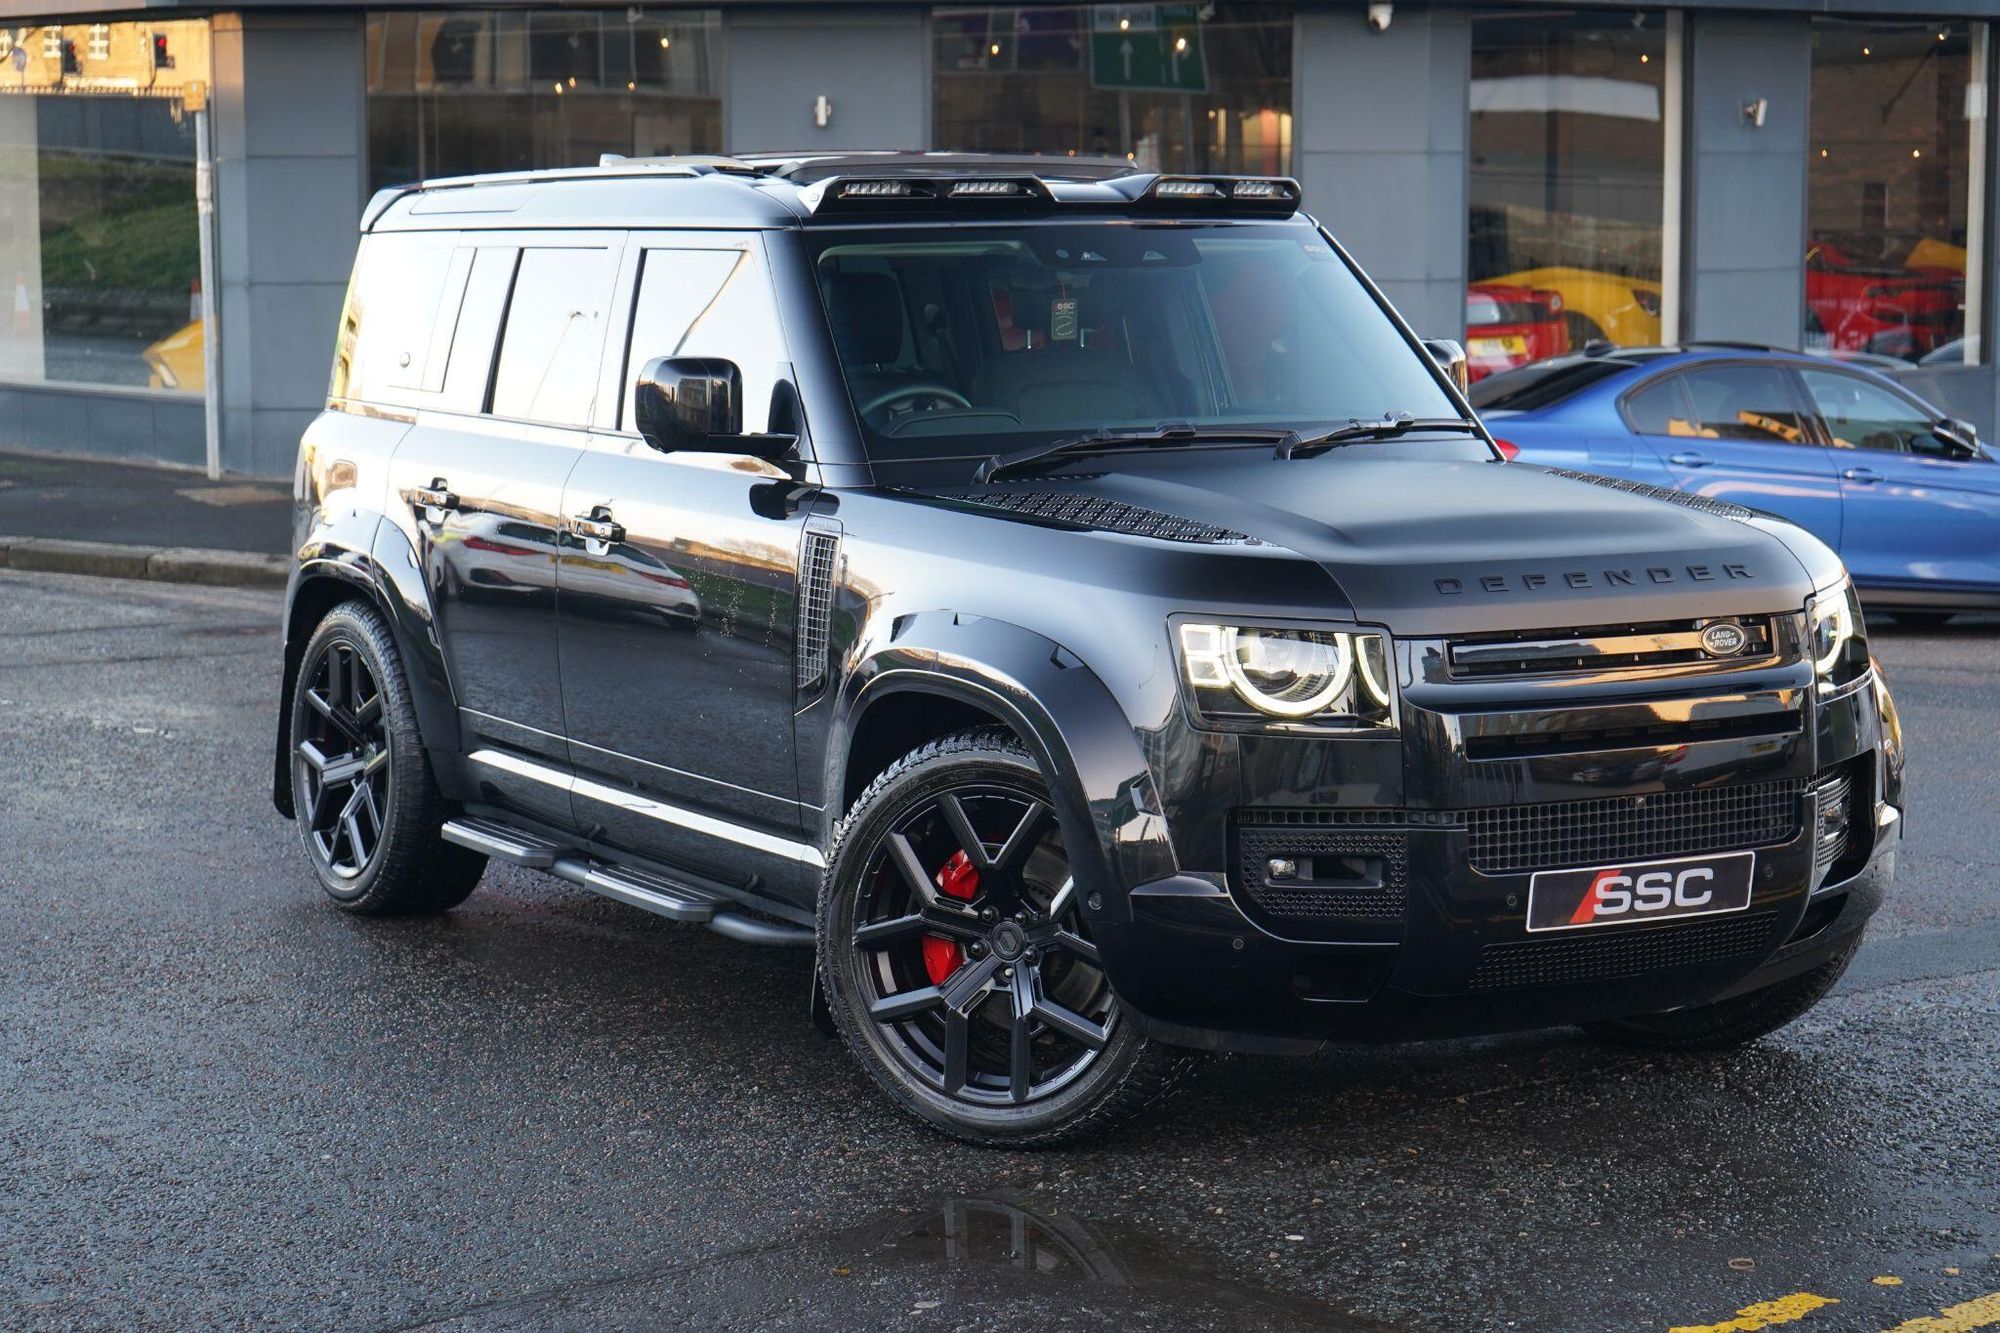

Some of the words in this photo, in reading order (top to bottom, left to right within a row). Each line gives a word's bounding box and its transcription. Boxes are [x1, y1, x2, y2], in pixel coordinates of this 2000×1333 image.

[1434, 563, 1754, 594] DEFENDER
[1714, 637, 1737, 647] ROVER
[1593, 867, 1714, 915] SSC
